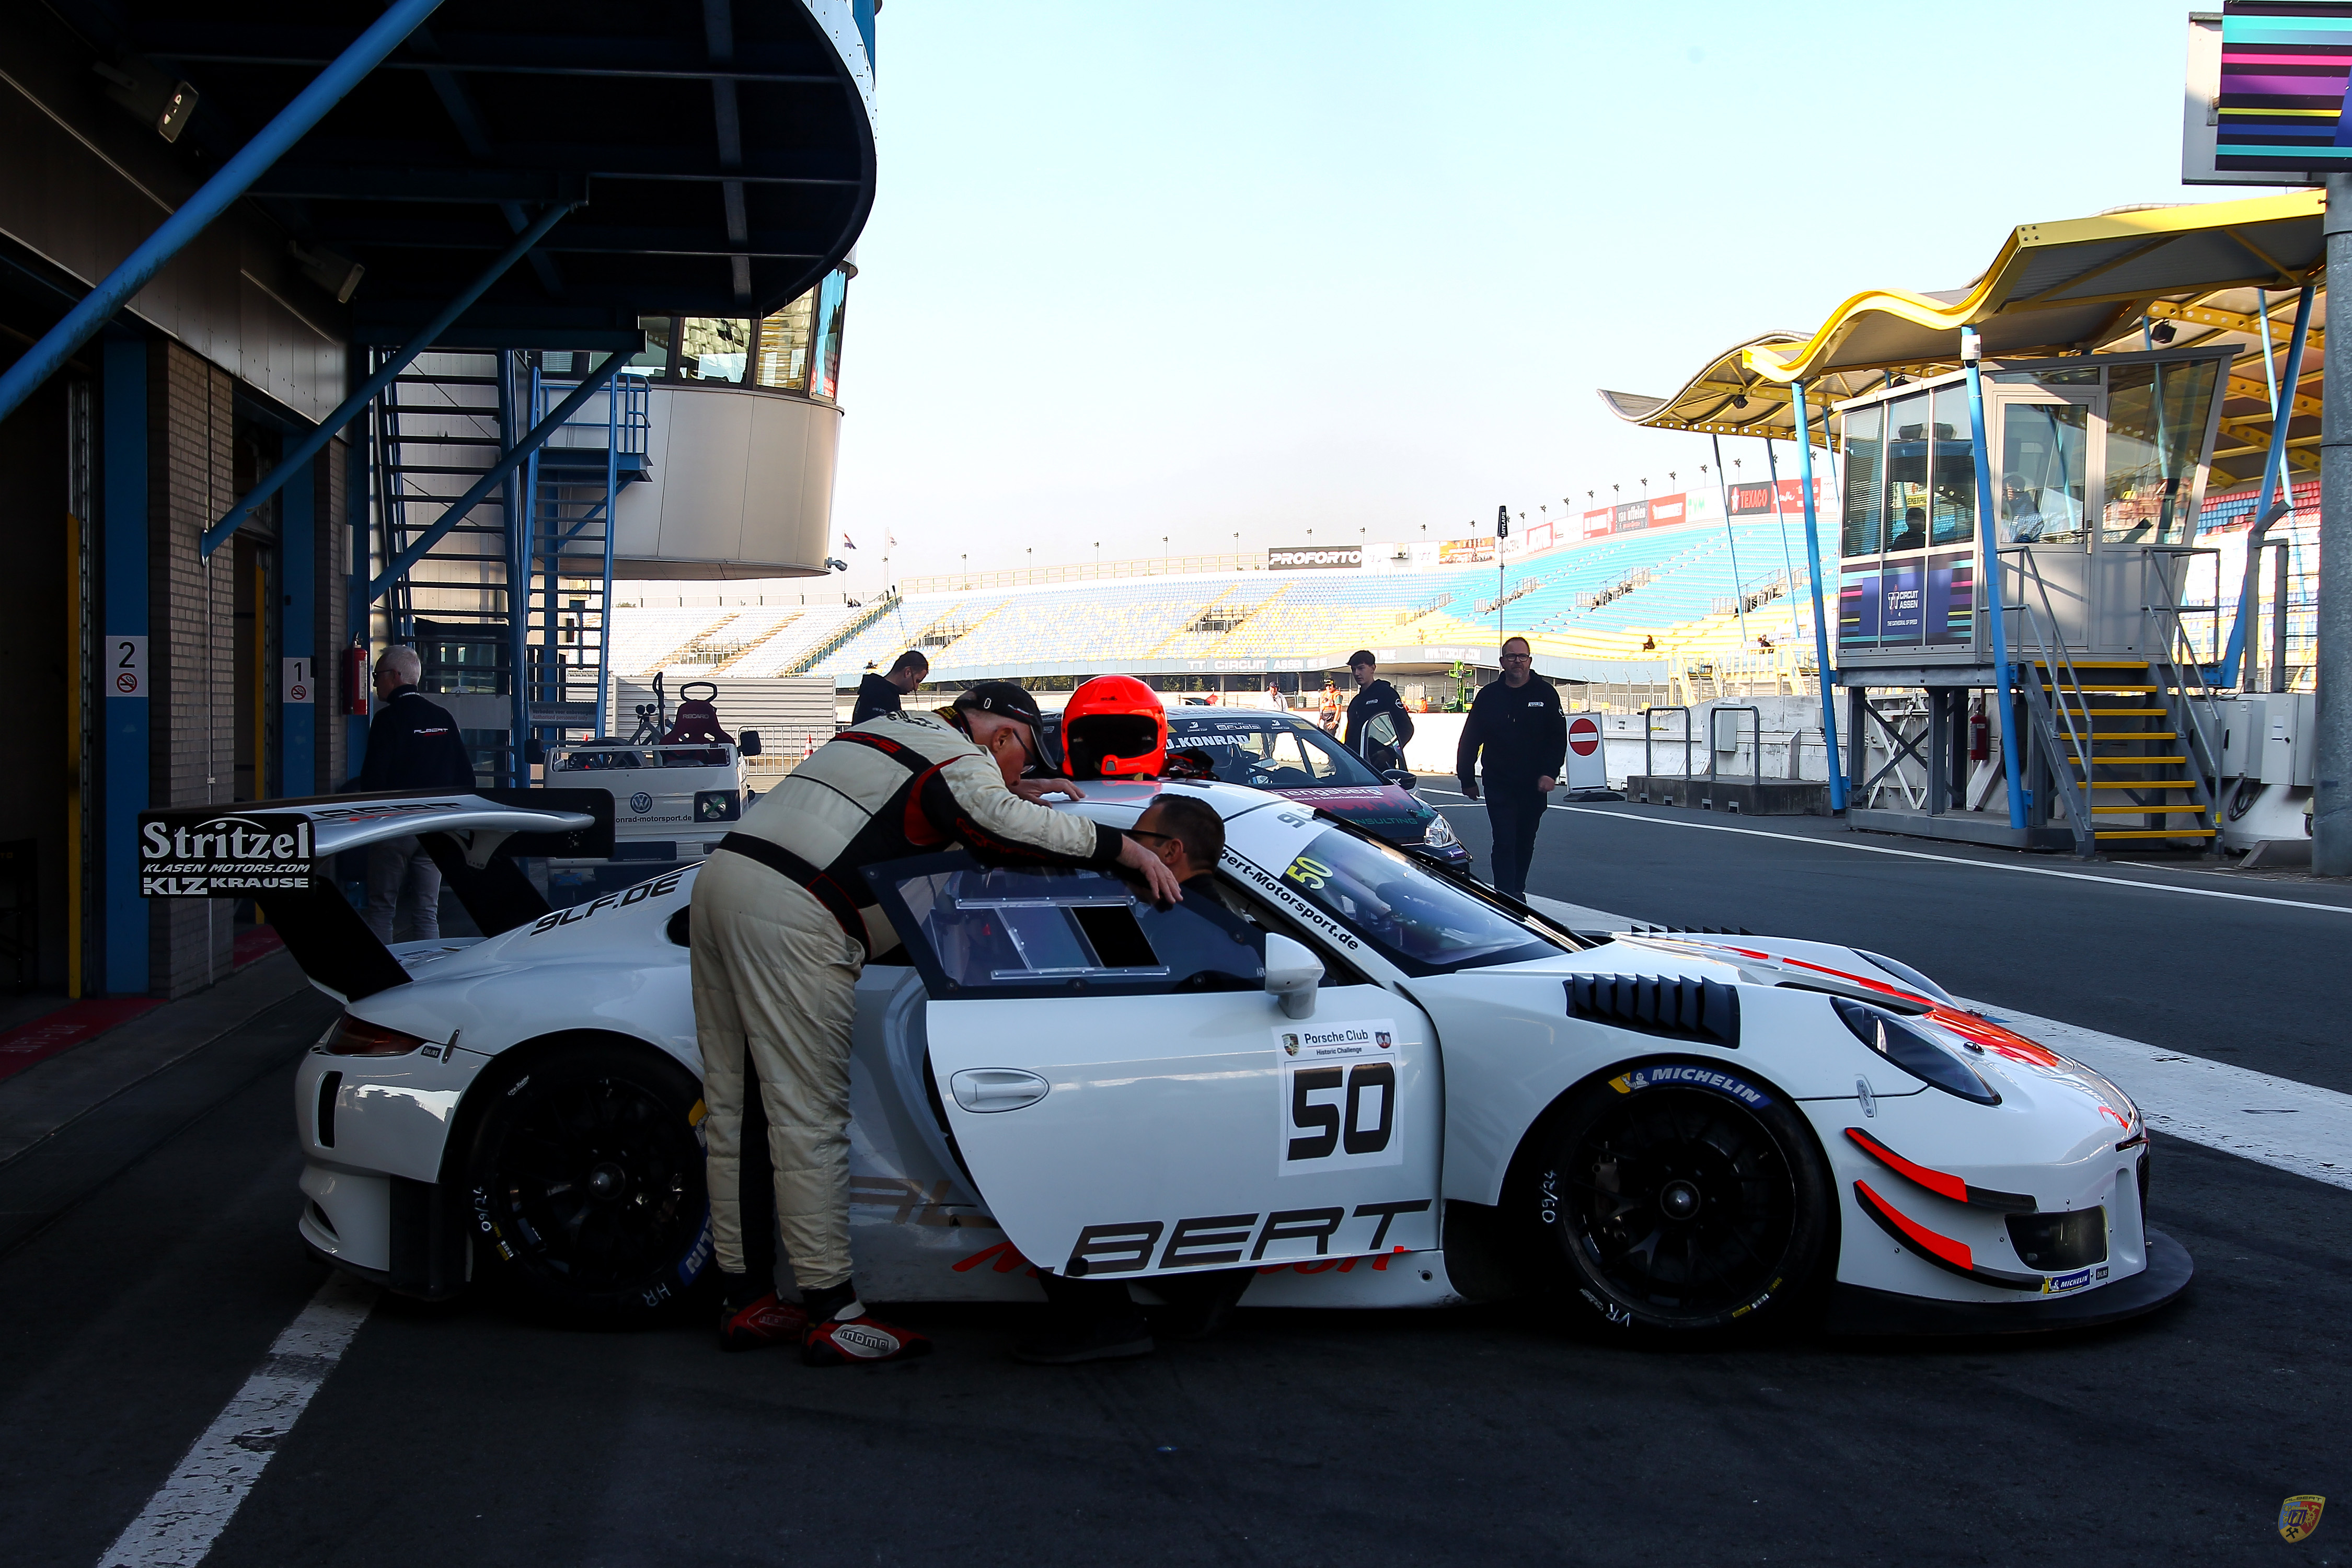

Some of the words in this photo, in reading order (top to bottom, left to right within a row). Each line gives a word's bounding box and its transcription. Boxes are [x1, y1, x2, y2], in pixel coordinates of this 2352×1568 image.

[1740, 489, 1768, 508] TEXACO
[1269, 550, 1362, 565] PROFORTO
[1899, 590, 1919, 599] CIRCUIT
[1899, 599, 1918, 609] ASSEN
[119, 641, 135, 668] 2
[294, 662, 302, 682] 1
[1187, 661, 1206, 670] TT
[1214, 660, 1267, 670] CIRCUIT
[1273, 660, 1304, 670] ASSEN
[142, 822, 310, 859] Stritzel
[143, 864, 207, 872] KLASEN
[209, 864, 310, 873] MOTORS.COM
[1286, 857, 1333, 889] 50
[143, 877, 208, 895] KLZ
[210, 878, 309, 888] KRAUSE
[1304, 1031, 1345, 1044] Porsche
[1345, 1029, 1369, 1041] Club
[1652, 1068, 1761, 1103] MICHELIN
[1287, 1062, 1396, 1161] 50
[1540, 1169, 1559, 1223] 09/24
[472, 1185, 492, 1231] 09/24
[2060, 1274, 2089, 1288] MICHELIN
[840, 1329, 889, 1351] momo
